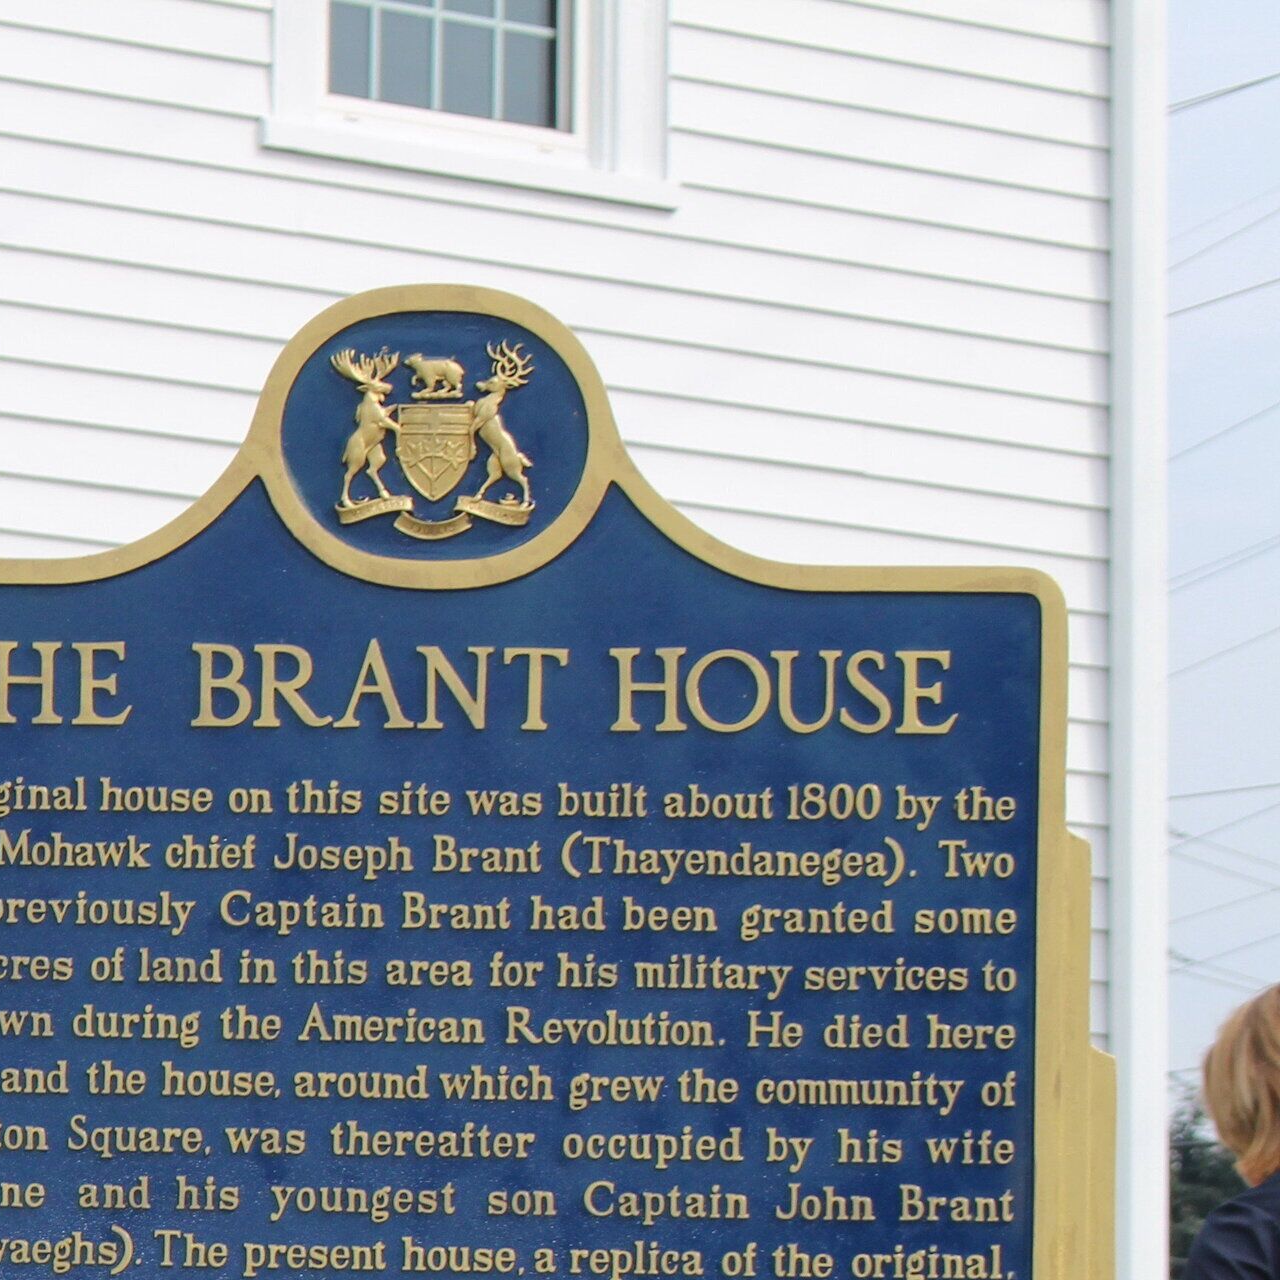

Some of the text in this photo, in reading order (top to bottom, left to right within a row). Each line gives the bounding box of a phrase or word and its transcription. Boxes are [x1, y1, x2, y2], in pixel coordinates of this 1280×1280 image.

[190, 638, 571, 732] BRANT
[608, 646, 959, 736] HOUSE
[99, 776, 215, 814] house
[227, 787, 275, 815] on
[286, 779, 364, 815] this
[378, 781, 453, 817] site
[465, 789, 544, 817] was
[557, 782, 649, 819] built
[663, 783, 774, 821] about
[787, 782, 883, 821] 1800
[894, 784, 943, 833] by
[954, 785, 1018, 822] the
[164, 833, 257, 870] chief
[272, 832, 415, 881] Joseph
[432, 833, 543, 874] Brant
[560, 830, 918, 888] (Thayendanegea).
[937, 838, 1017, 879] Two
[219, 889, 386, 936] Captain
[401, 890, 512, 931] Brant
[530, 894, 607, 932] had
[622, 895, 719, 933] been
[739, 898, 895, 943] granted
[913, 906, 1019, 936] some
[90, 946, 126, 983] of
[138, 946, 225, 984] land
[239, 949, 278, 985] in
[292, 948, 370, 986] this
[385, 958, 475, 988] area
[489, 950, 546, 988] for
[557, 951, 620, 989] his
[633, 954, 794, 1002] military
[803, 957, 970, 992] services
[982, 962, 1018, 993] to
[71, 1003, 201, 1050] during
[219, 1003, 283, 1041] the
[298, 1003, 487, 1045] American
[504, 1005, 727, 1048] Revolution.
[747, 1009, 805, 1049] He
[822, 1013, 911, 1050] died
[927, 1013, 1018, 1051] here
[0, 1059, 71, 1095] and
[86, 1059, 148, 1096] the
[161, 1059, 282, 1098] house,
[292, 1063, 430, 1100] around
[438, 1064, 556, 1102] which
[568, 1071, 666, 1112] grew
[677, 1067, 741, 1105] the
[754, 1070, 965, 1117] community
[980, 1070, 1017, 1108] of
[67, 1114, 212, 1159] Square,
[225, 1126, 307, 1156] was
[330, 1119, 537, 1159] thereafter
[562, 1125, 744, 1170] occupied
[766, 1126, 814, 1174] by
[837, 1127, 904, 1165] his
[926, 1130, 1016, 1166] wife
[78, 1174, 151, 1210] and
[176, 1174, 242, 1212] his
[269, 1182, 457, 1224] youngest
[487, 1189, 558, 1217] son
[582, 1179, 751, 1227] Captain
[775, 1182, 877, 1222] John
[899, 1183, 1015, 1223] Brant
[153, 1228, 230, 1269] The
[243, 1241, 388, 1279] present
[401, 1235, 526, 1276] house,
[533, 1246, 558, 1274] a
[721, 1242, 758, 1278] of
[772, 1243, 835, 1279] the
